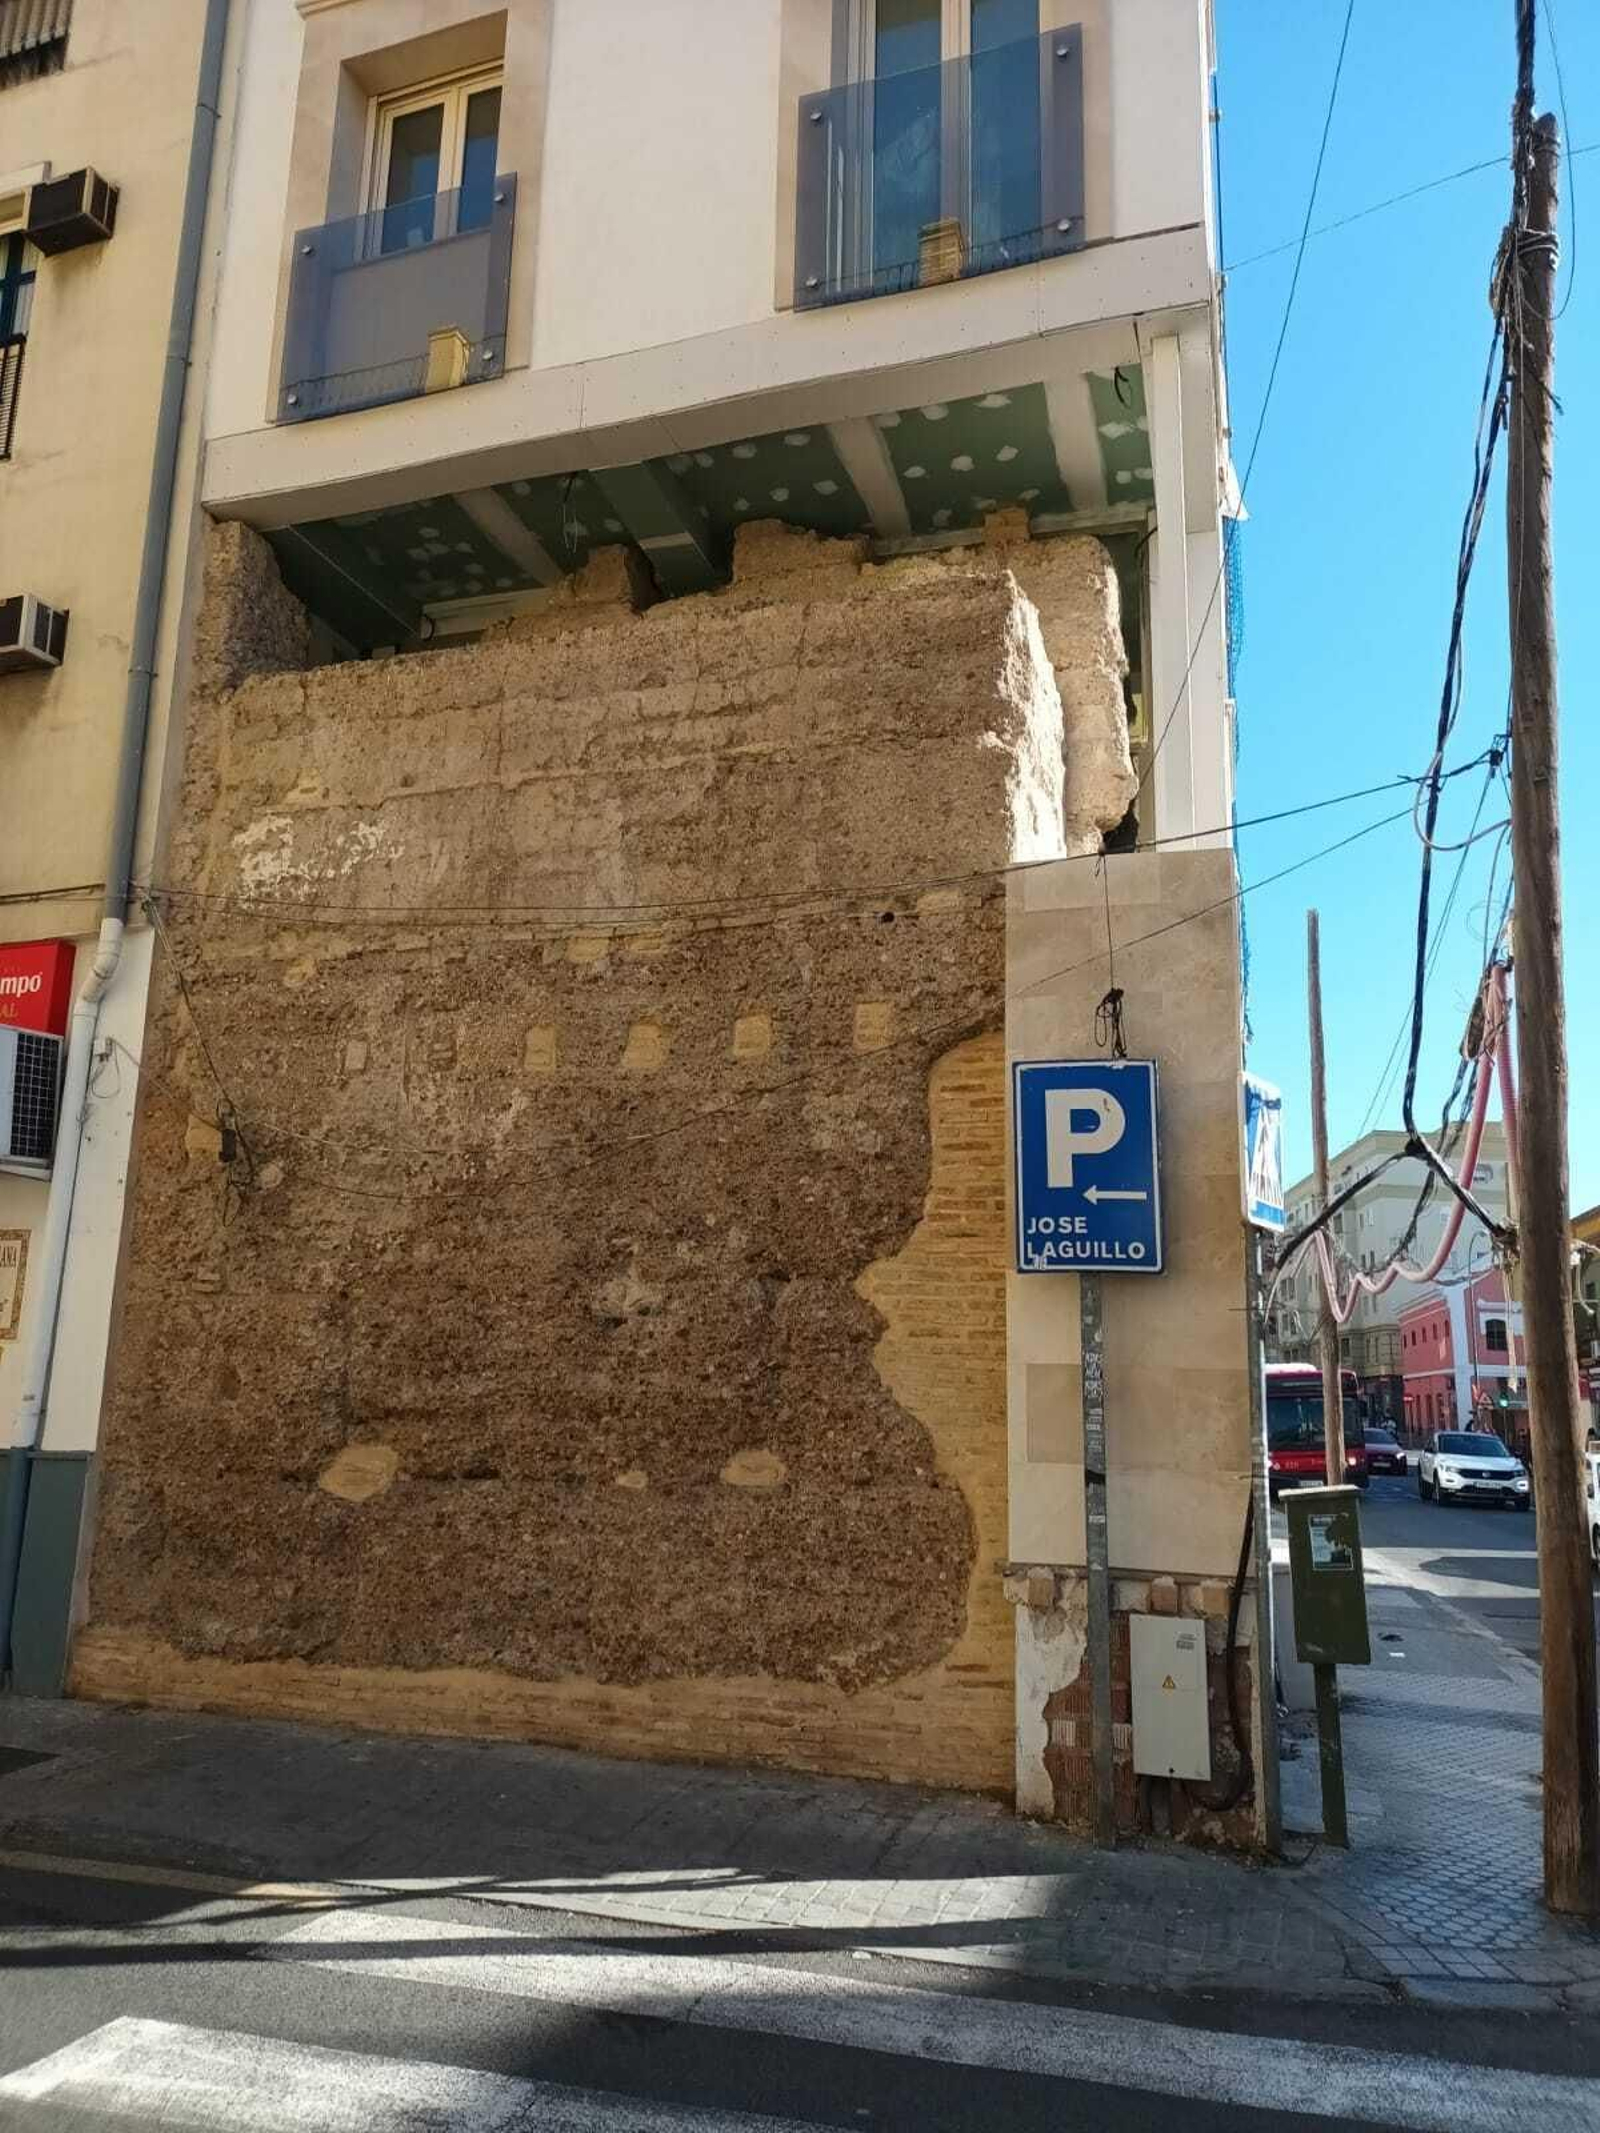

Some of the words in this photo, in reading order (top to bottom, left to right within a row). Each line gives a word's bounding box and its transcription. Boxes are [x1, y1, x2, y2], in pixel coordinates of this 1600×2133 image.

[1045, 1088, 1126, 1188] P
[1027, 1216, 1088, 1234] JOSE
[1027, 1241, 1146, 1260] LAGUILLO
